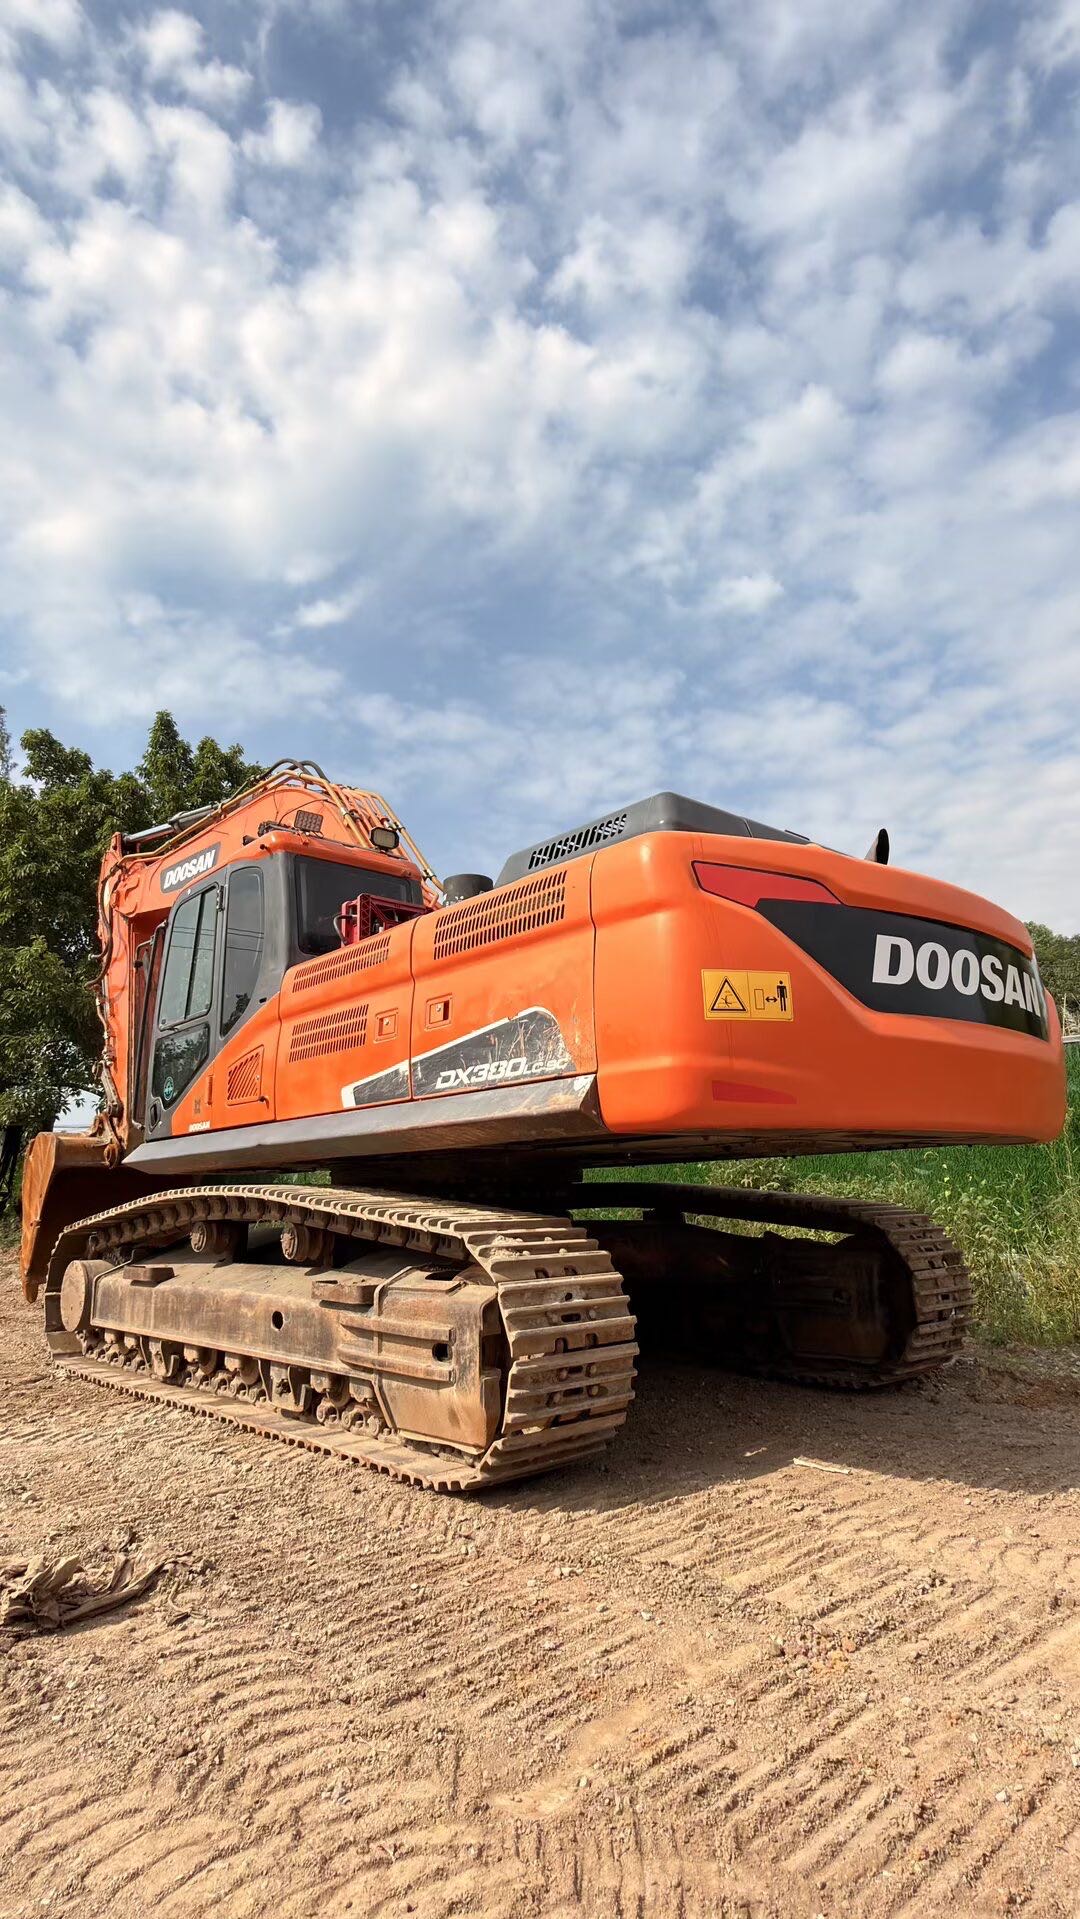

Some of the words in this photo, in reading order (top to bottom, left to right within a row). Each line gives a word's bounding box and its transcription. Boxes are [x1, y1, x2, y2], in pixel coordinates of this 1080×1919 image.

[163, 849, 216, 889] DOOSAN
[872, 934, 1041, 1017] DOOSAN
[188, 1121, 211, 1132] DOOSAN
